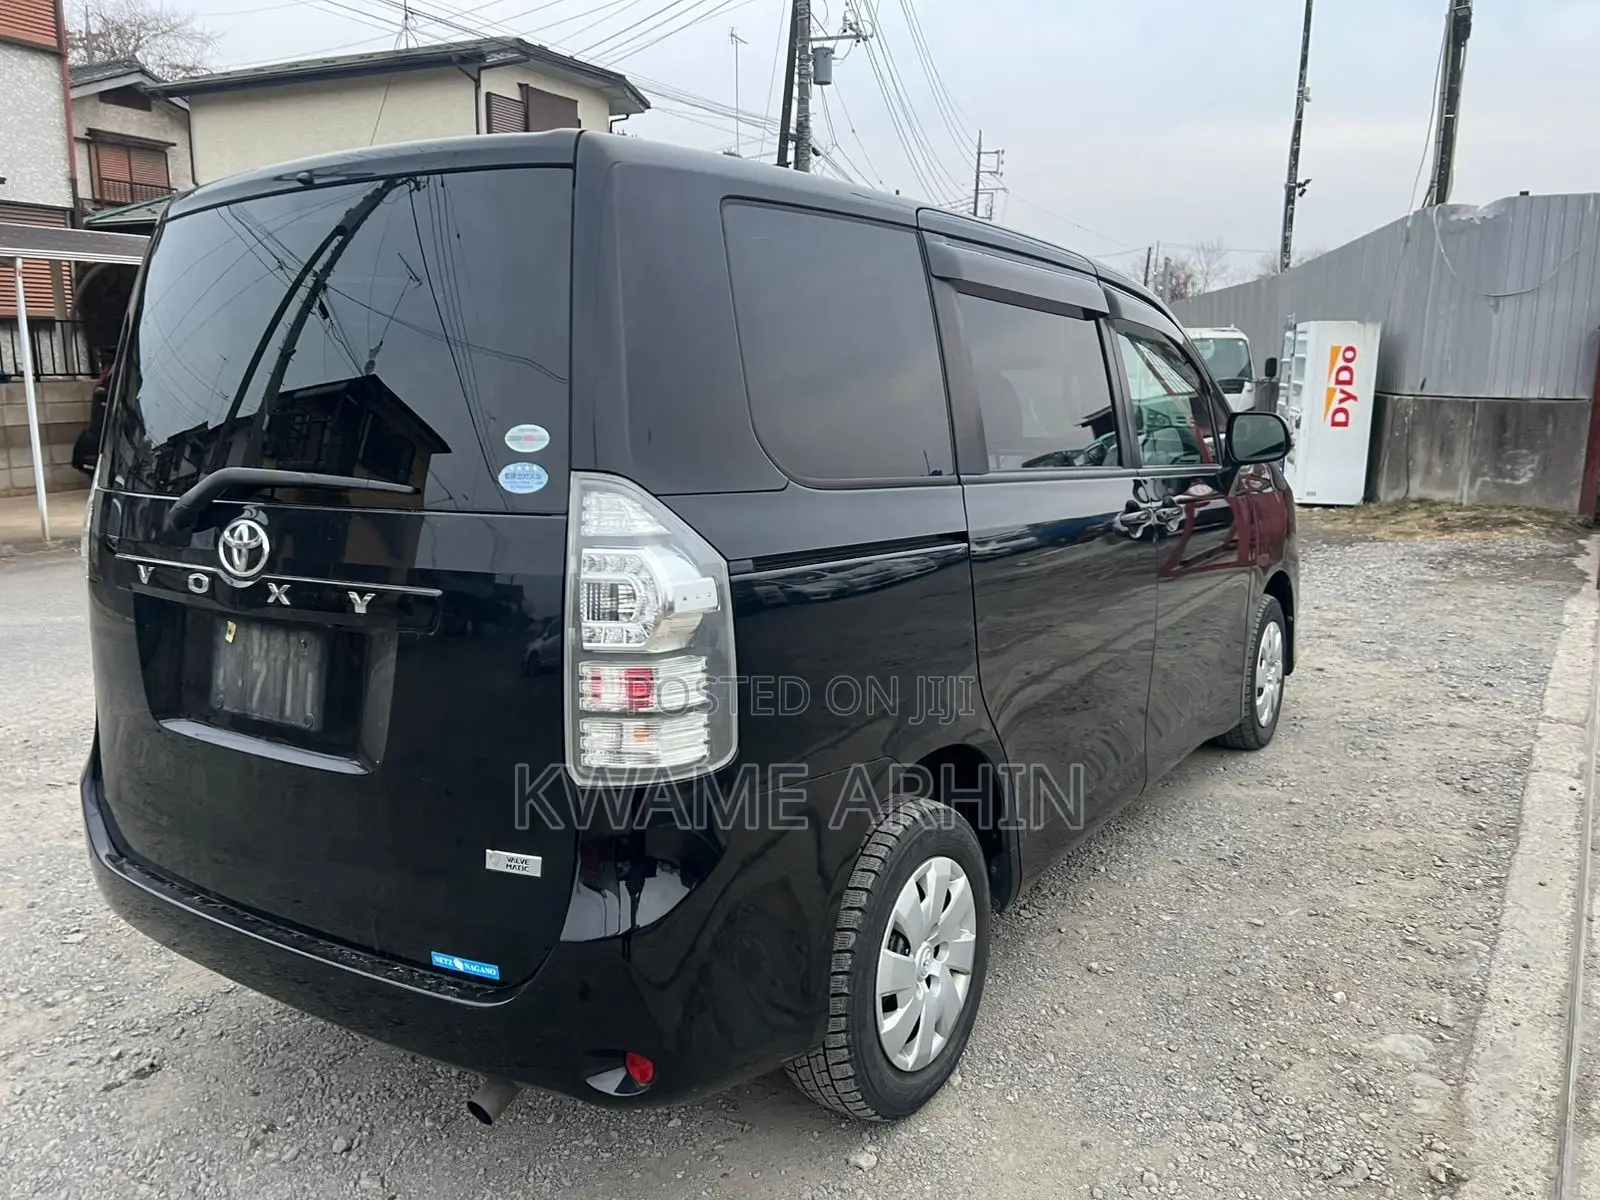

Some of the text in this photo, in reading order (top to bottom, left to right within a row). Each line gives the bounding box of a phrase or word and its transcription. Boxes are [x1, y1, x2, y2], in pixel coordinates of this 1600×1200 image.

[1331, 346, 1358, 427] DyDo
[137, 564, 376, 614] VOXY
[505, 856, 530, 866] VALVE
[505, 863, 530, 873] MATIC
[464, 962, 497, 976] NAGANO
